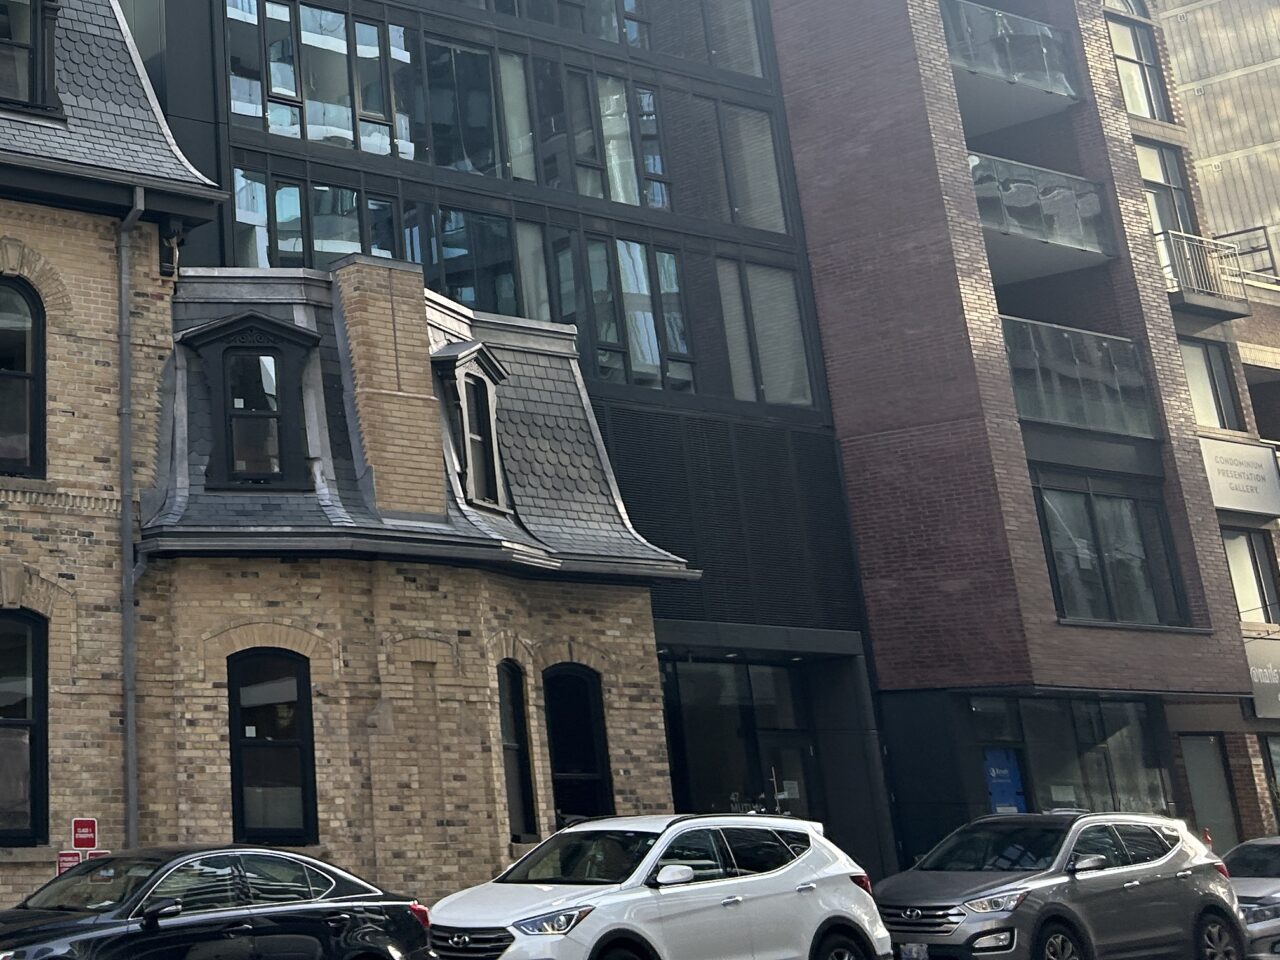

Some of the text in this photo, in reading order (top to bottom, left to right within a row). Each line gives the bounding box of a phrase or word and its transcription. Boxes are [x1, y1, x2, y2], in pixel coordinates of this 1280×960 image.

[1214, 455, 1264, 470] CONDOMINIUM
[1217, 468, 1267, 482] PRESENTATION
[1228, 482, 1260, 494] GALLERY
